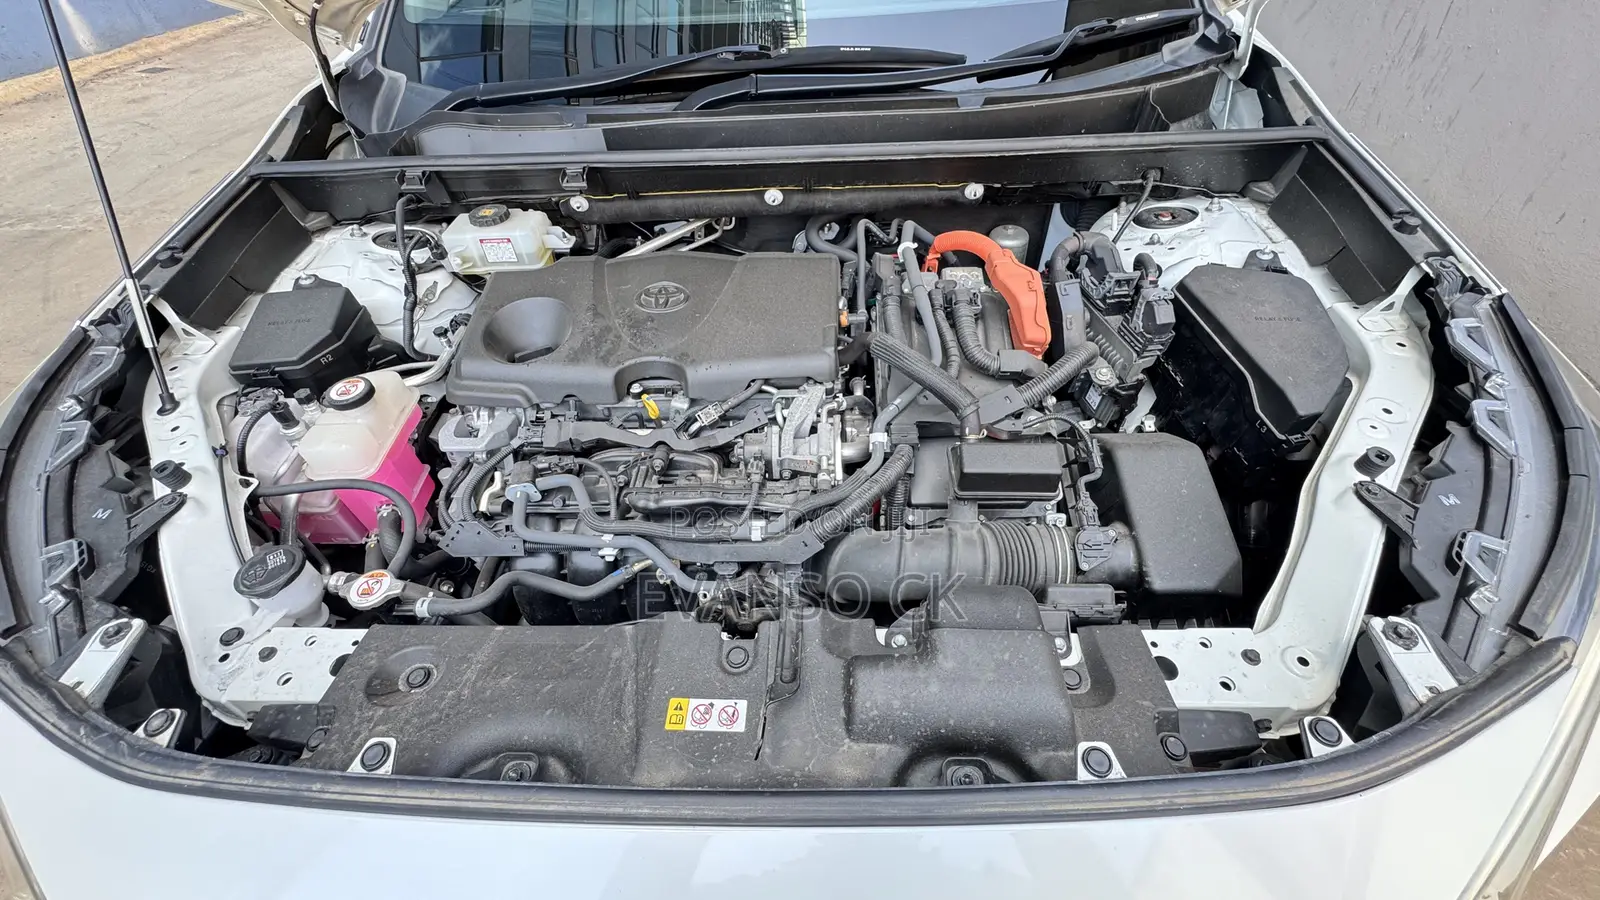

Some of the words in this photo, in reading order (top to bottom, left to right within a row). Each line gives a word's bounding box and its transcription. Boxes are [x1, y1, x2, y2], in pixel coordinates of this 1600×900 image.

[320, 354, 334, 365] R2
[1255, 419, 1268, 433] L3
[91, 508, 113, 520] M
